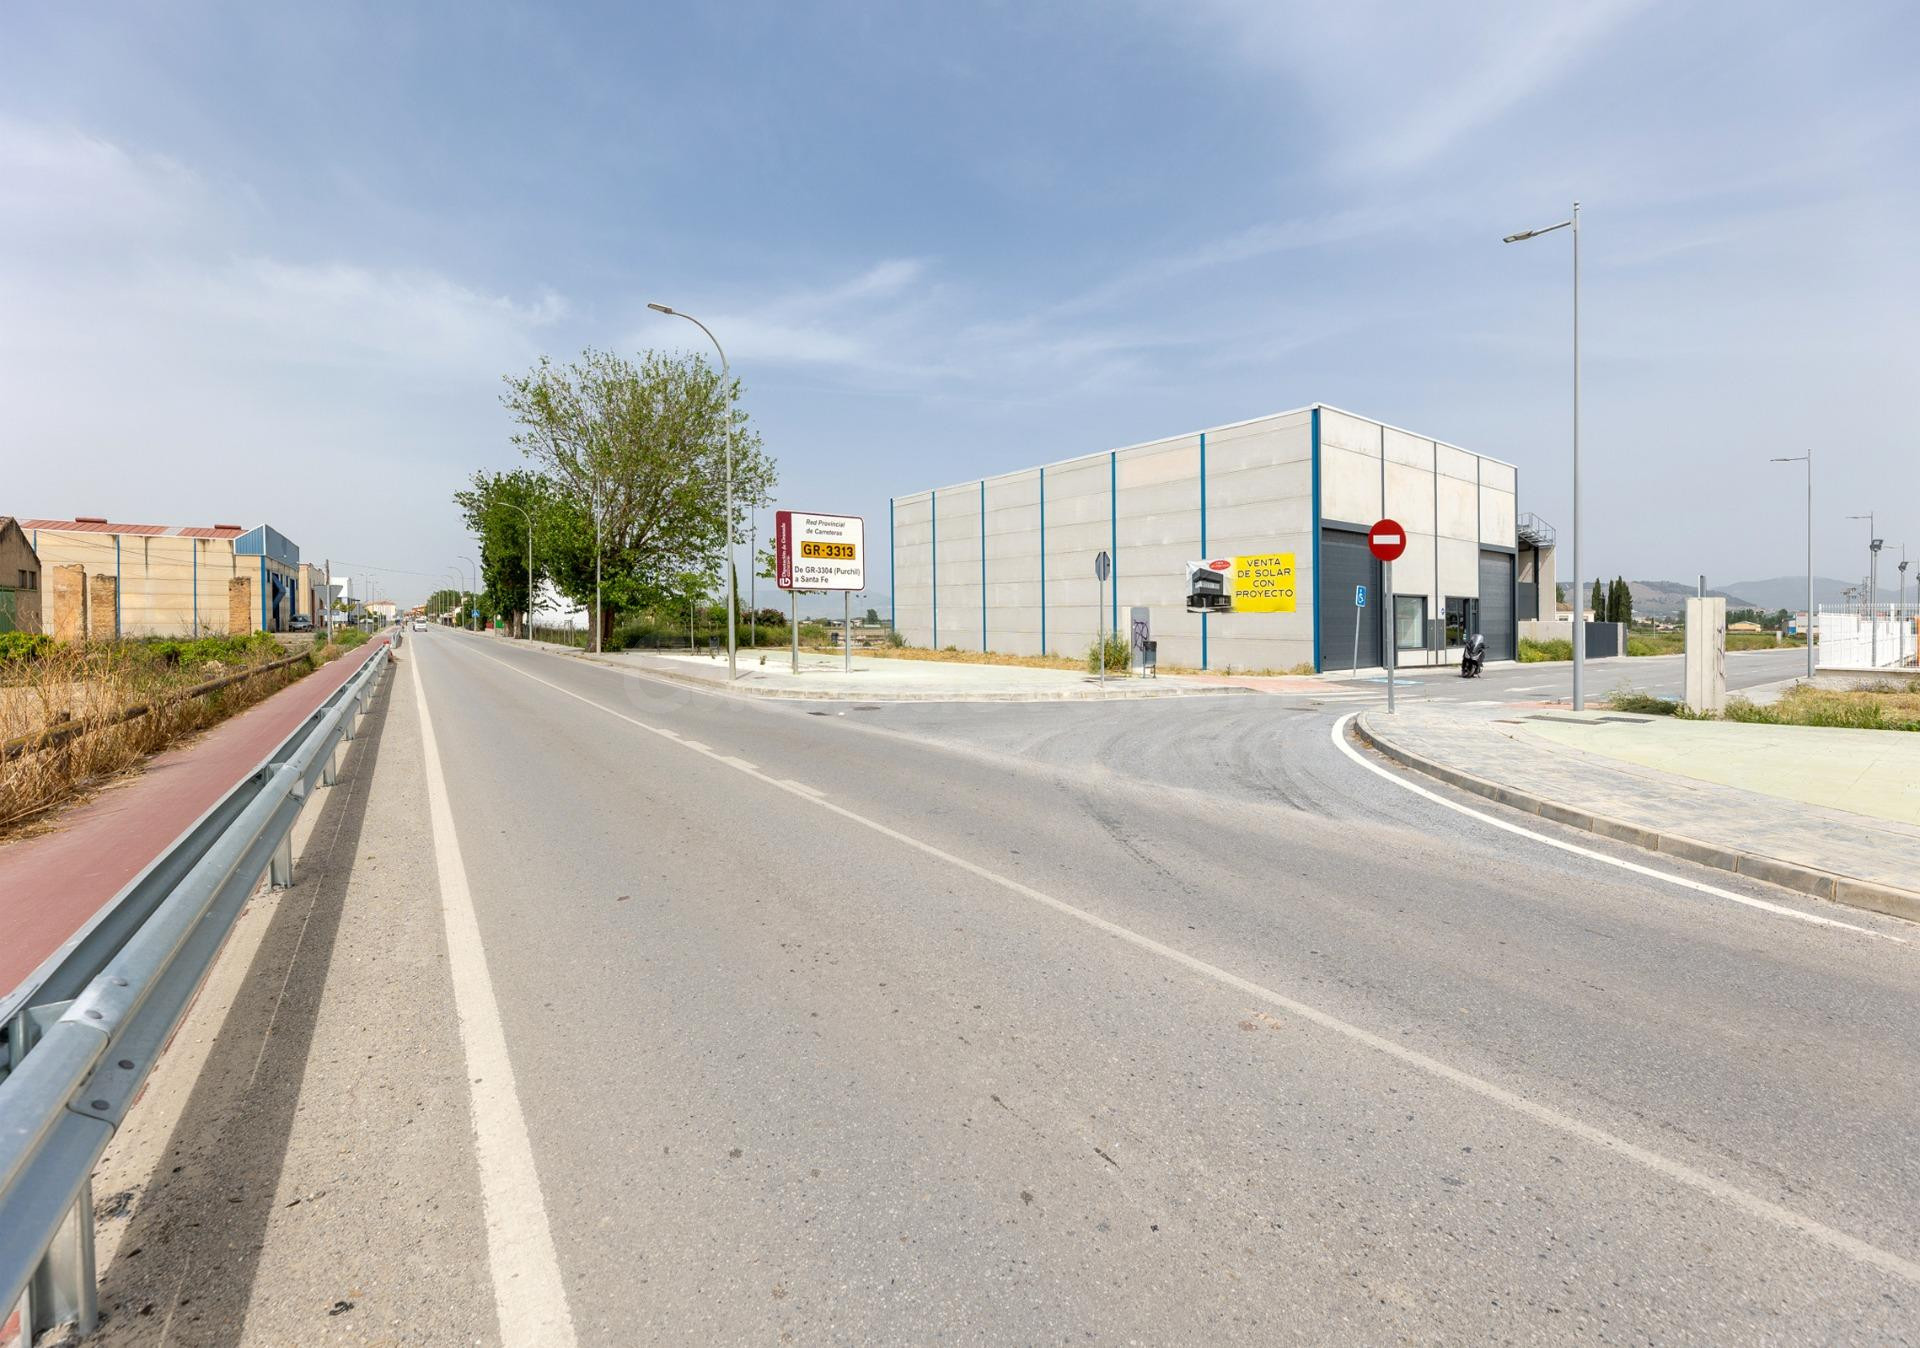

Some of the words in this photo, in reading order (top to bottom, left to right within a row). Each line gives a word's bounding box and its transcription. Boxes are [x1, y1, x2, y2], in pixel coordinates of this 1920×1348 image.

[818, 520, 846, 528] Provincial
[814, 528, 843, 536] Carreteras
[803, 544, 854, 557] GR-3313
[1247, 558, 1281, 567] VENTA
[805, 566, 833, 574] GR-3304
[1237, 570, 1251, 578] DE
[1254, 568, 1291, 578] SOLAR
[800, 575, 819, 583] Santa
[1252, 579, 1275, 588] CON
[1235, 589, 1294, 598] PROYECTO
